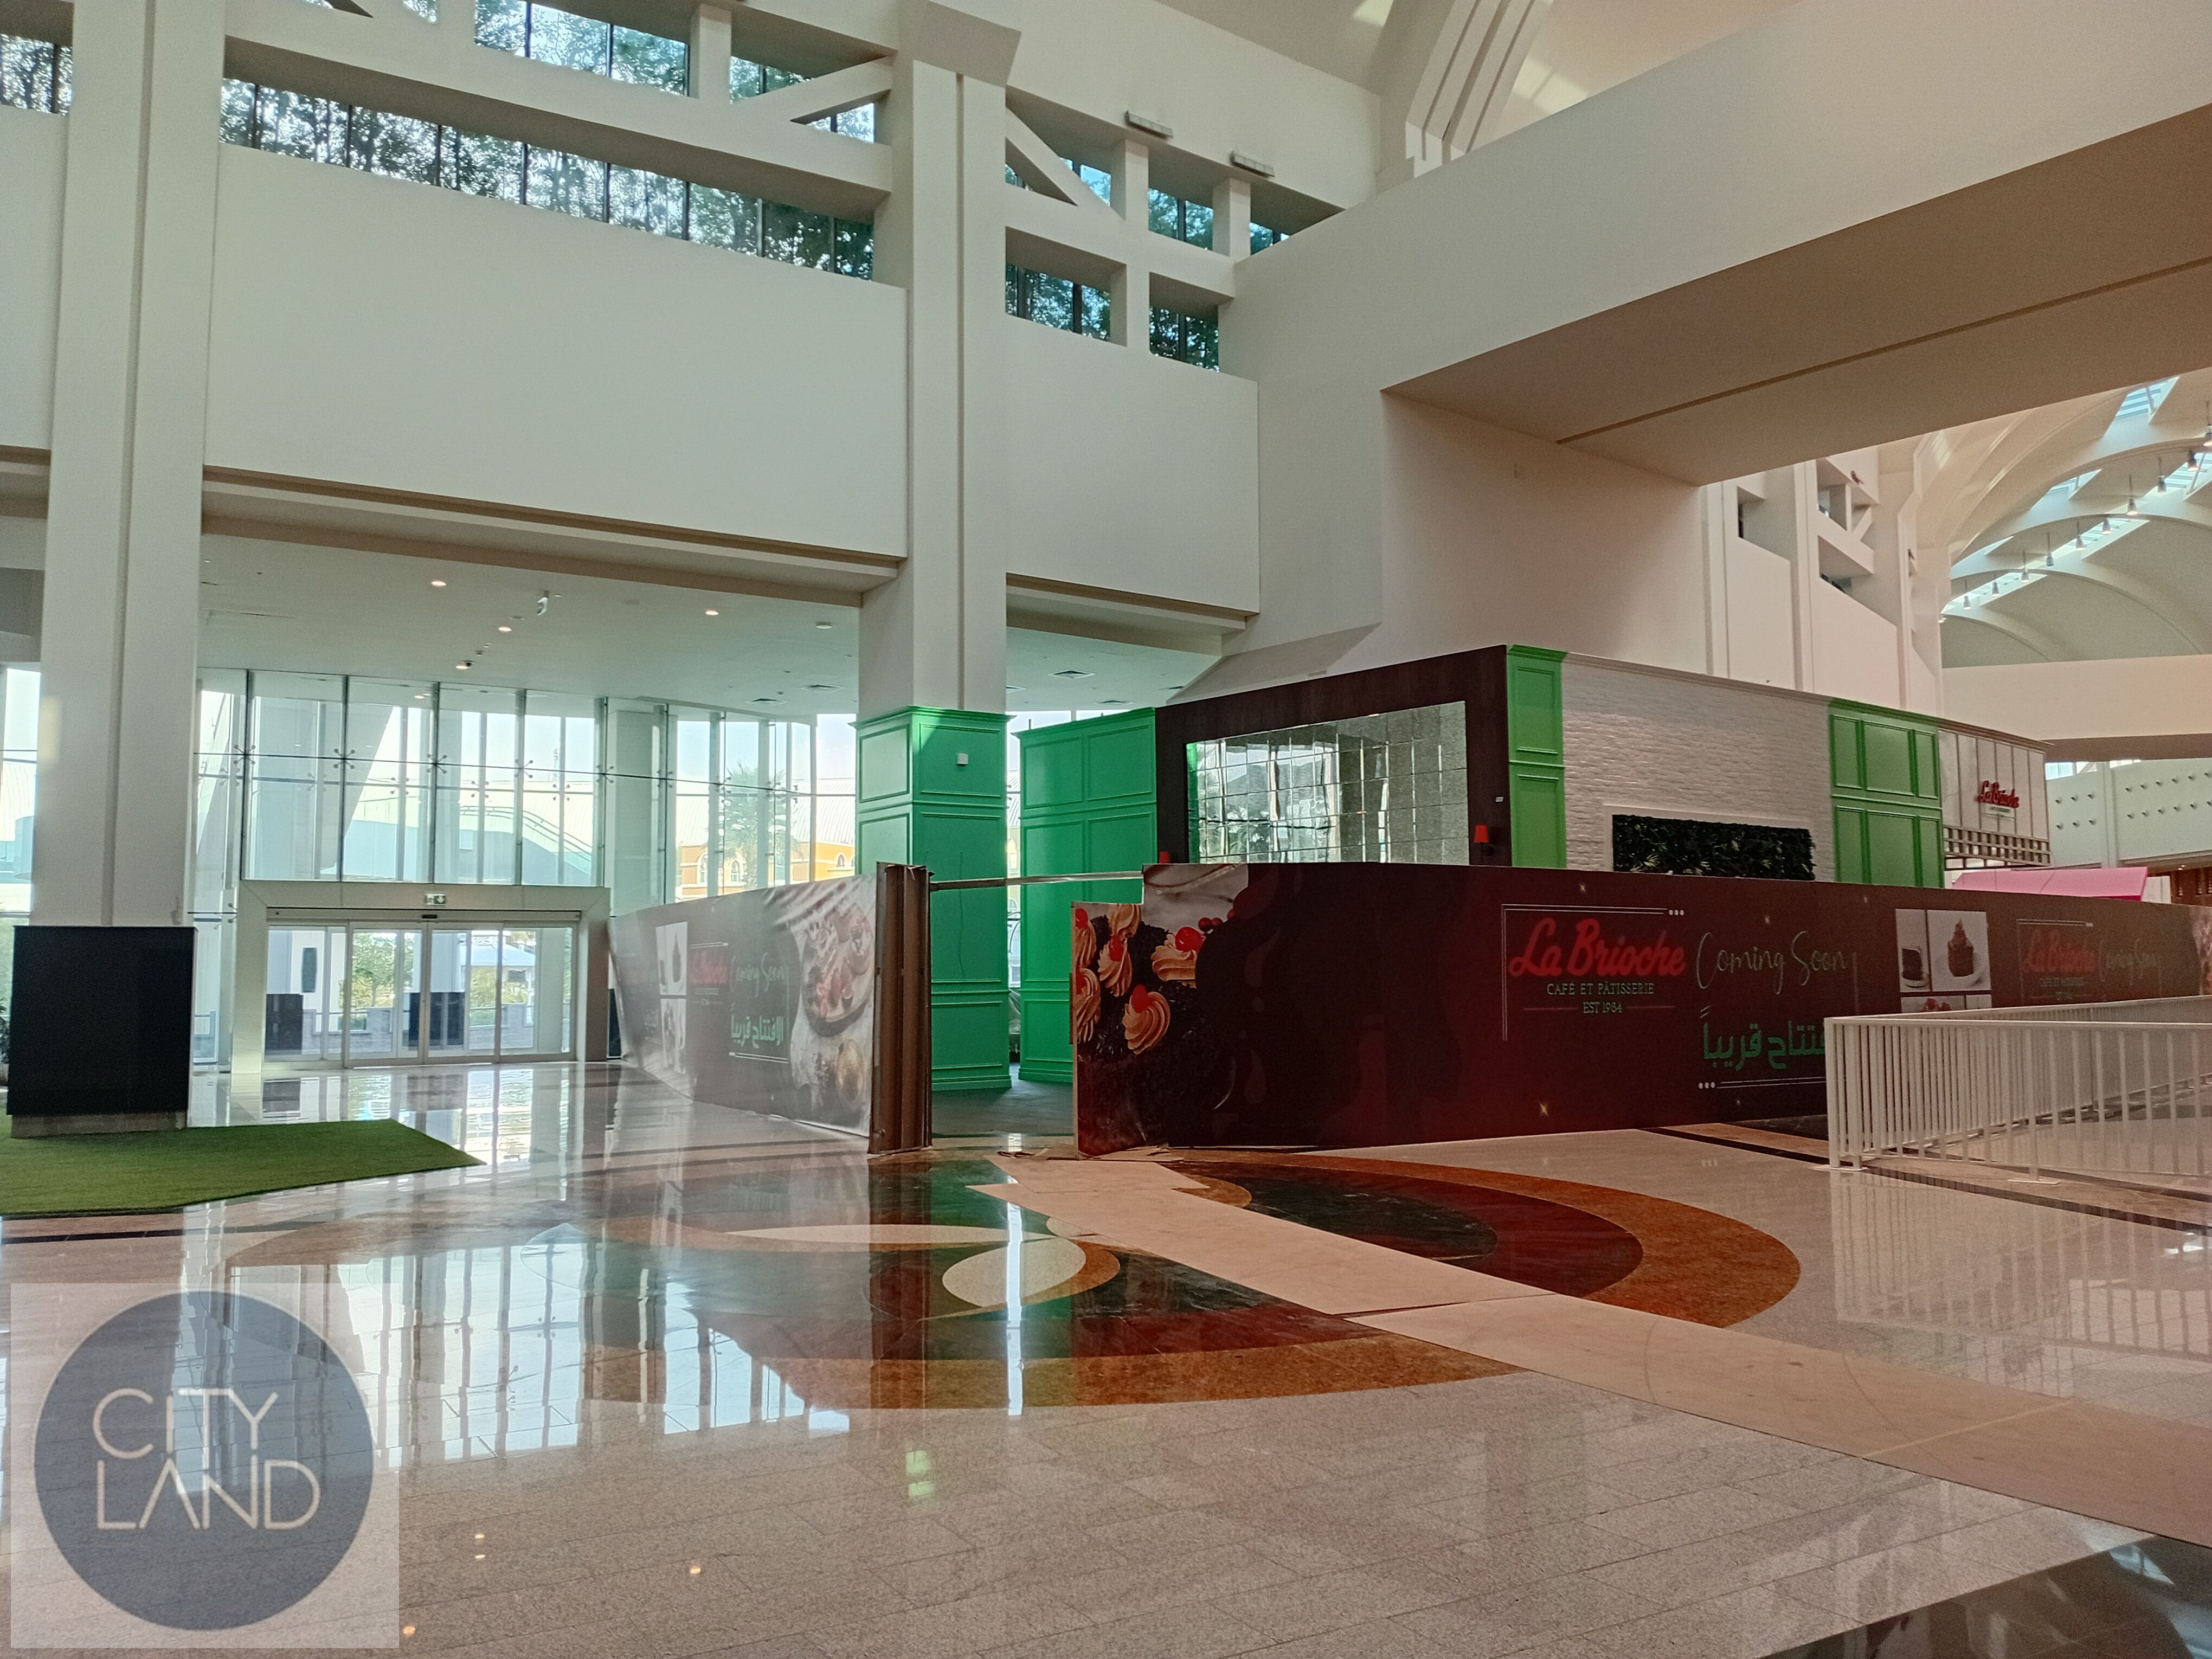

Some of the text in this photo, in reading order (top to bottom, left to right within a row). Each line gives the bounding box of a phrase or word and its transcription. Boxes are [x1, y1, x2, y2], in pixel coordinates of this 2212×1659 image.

[1508, 917, 1686, 976] La Brioche
[1696, 931, 1846, 995] Coming Soon
[1580, 982, 1594, 995] ET
[1583, 1001, 1623, 1013] EST 1984
